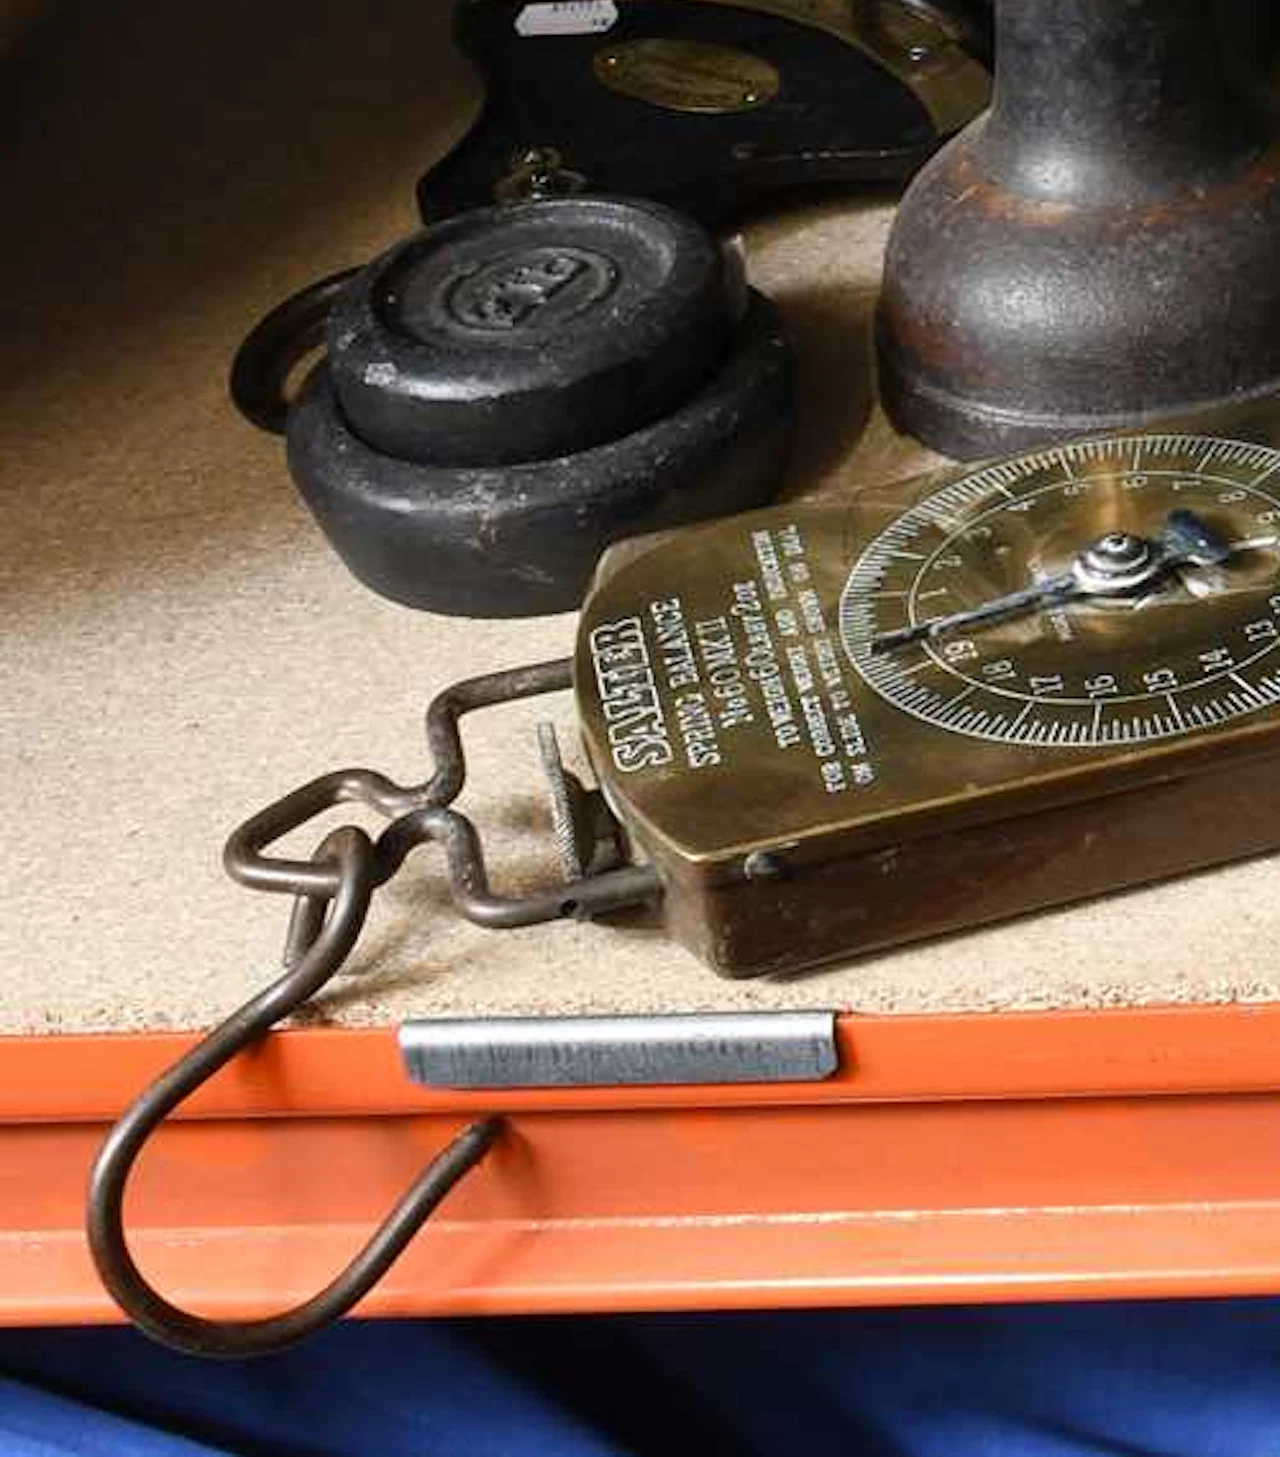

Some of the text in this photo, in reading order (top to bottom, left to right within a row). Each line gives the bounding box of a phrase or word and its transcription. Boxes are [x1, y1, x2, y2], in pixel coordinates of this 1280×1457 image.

[1245, 619, 1278, 642] 13
[943, 639, 978, 662] 19
[1199, 647, 1234, 672] 14
[982, 658, 1017, 682] 18
[1143, 668, 1178, 692] 15
[590, 616, 673, 772] SALTER
[651, 597, 721, 769] SPRING BALANCE
[1030, 674, 1064, 694] 17
[1084, 674, 1118, 698] 16
[801, 695, 836, 757] CORRECT
[821, 761, 846, 793] FOR
